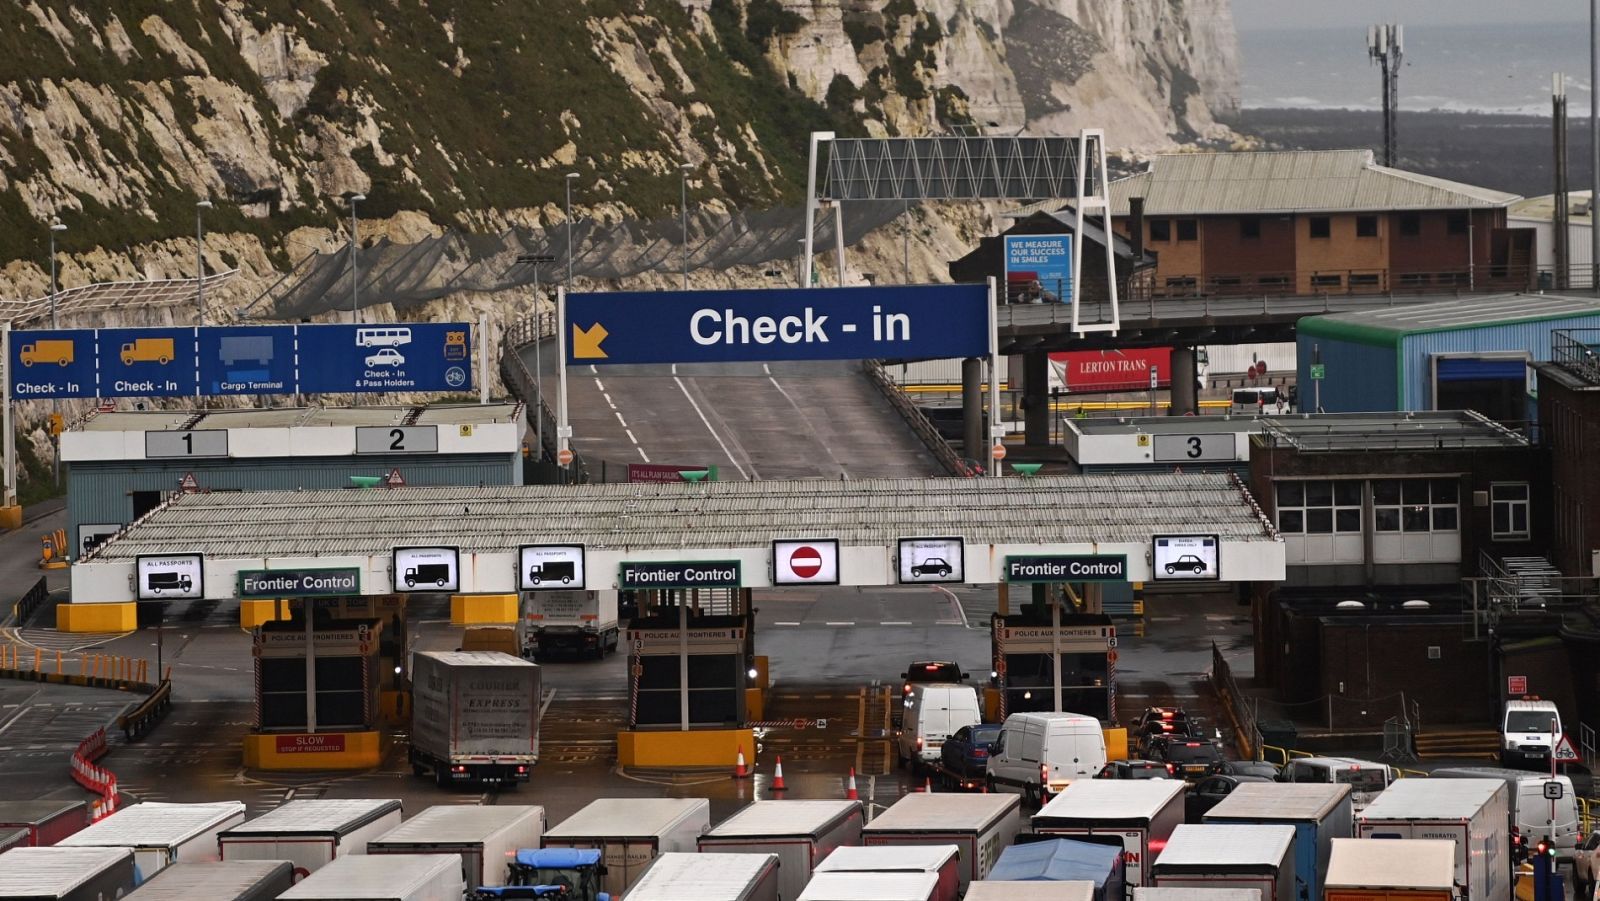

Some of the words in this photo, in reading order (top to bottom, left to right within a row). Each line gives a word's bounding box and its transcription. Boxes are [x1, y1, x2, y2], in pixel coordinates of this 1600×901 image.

[1010, 241, 1023, 249] WE
[1025, 240, 1063, 248] MEASURE
[1010, 248, 1028, 256] OUR
[690, 307, 830, 346] Check
[873, 305, 910, 341] in
[1080, 361, 1116, 374] LERTON
[1117, 359, 1147, 372] TRANS
[364, 369, 390, 378] Check
[397, 369, 406, 378] In
[15, 382, 56, 393] Check
[67, 382, 79, 393] In
[114, 381, 154, 392] Check
[166, 380, 178, 391] In
[220, 382, 246, 391] Cargo
[248, 381, 283, 391] Terminal
[355, 379, 363, 387] &
[363, 379, 383, 388] Pass
[384, 378, 415, 388] Holders
[182, 433, 193, 454] 1
[389, 429, 405, 450] 2
[1186, 436, 1203, 458] 3
[1011, 562, 1067, 576] Frontier
[1070, 561, 1122, 575] Control
[625, 568, 680, 582] Frontier
[684, 567, 736, 581] Control
[244, 577, 299, 591] Frontier
[302, 575, 355, 589] Control
[360, 625, 367, 633] 2
[636, 640, 642, 649] 3
[469, 698, 521, 708] EXPRESS
[296, 736, 324, 746] SLOW
